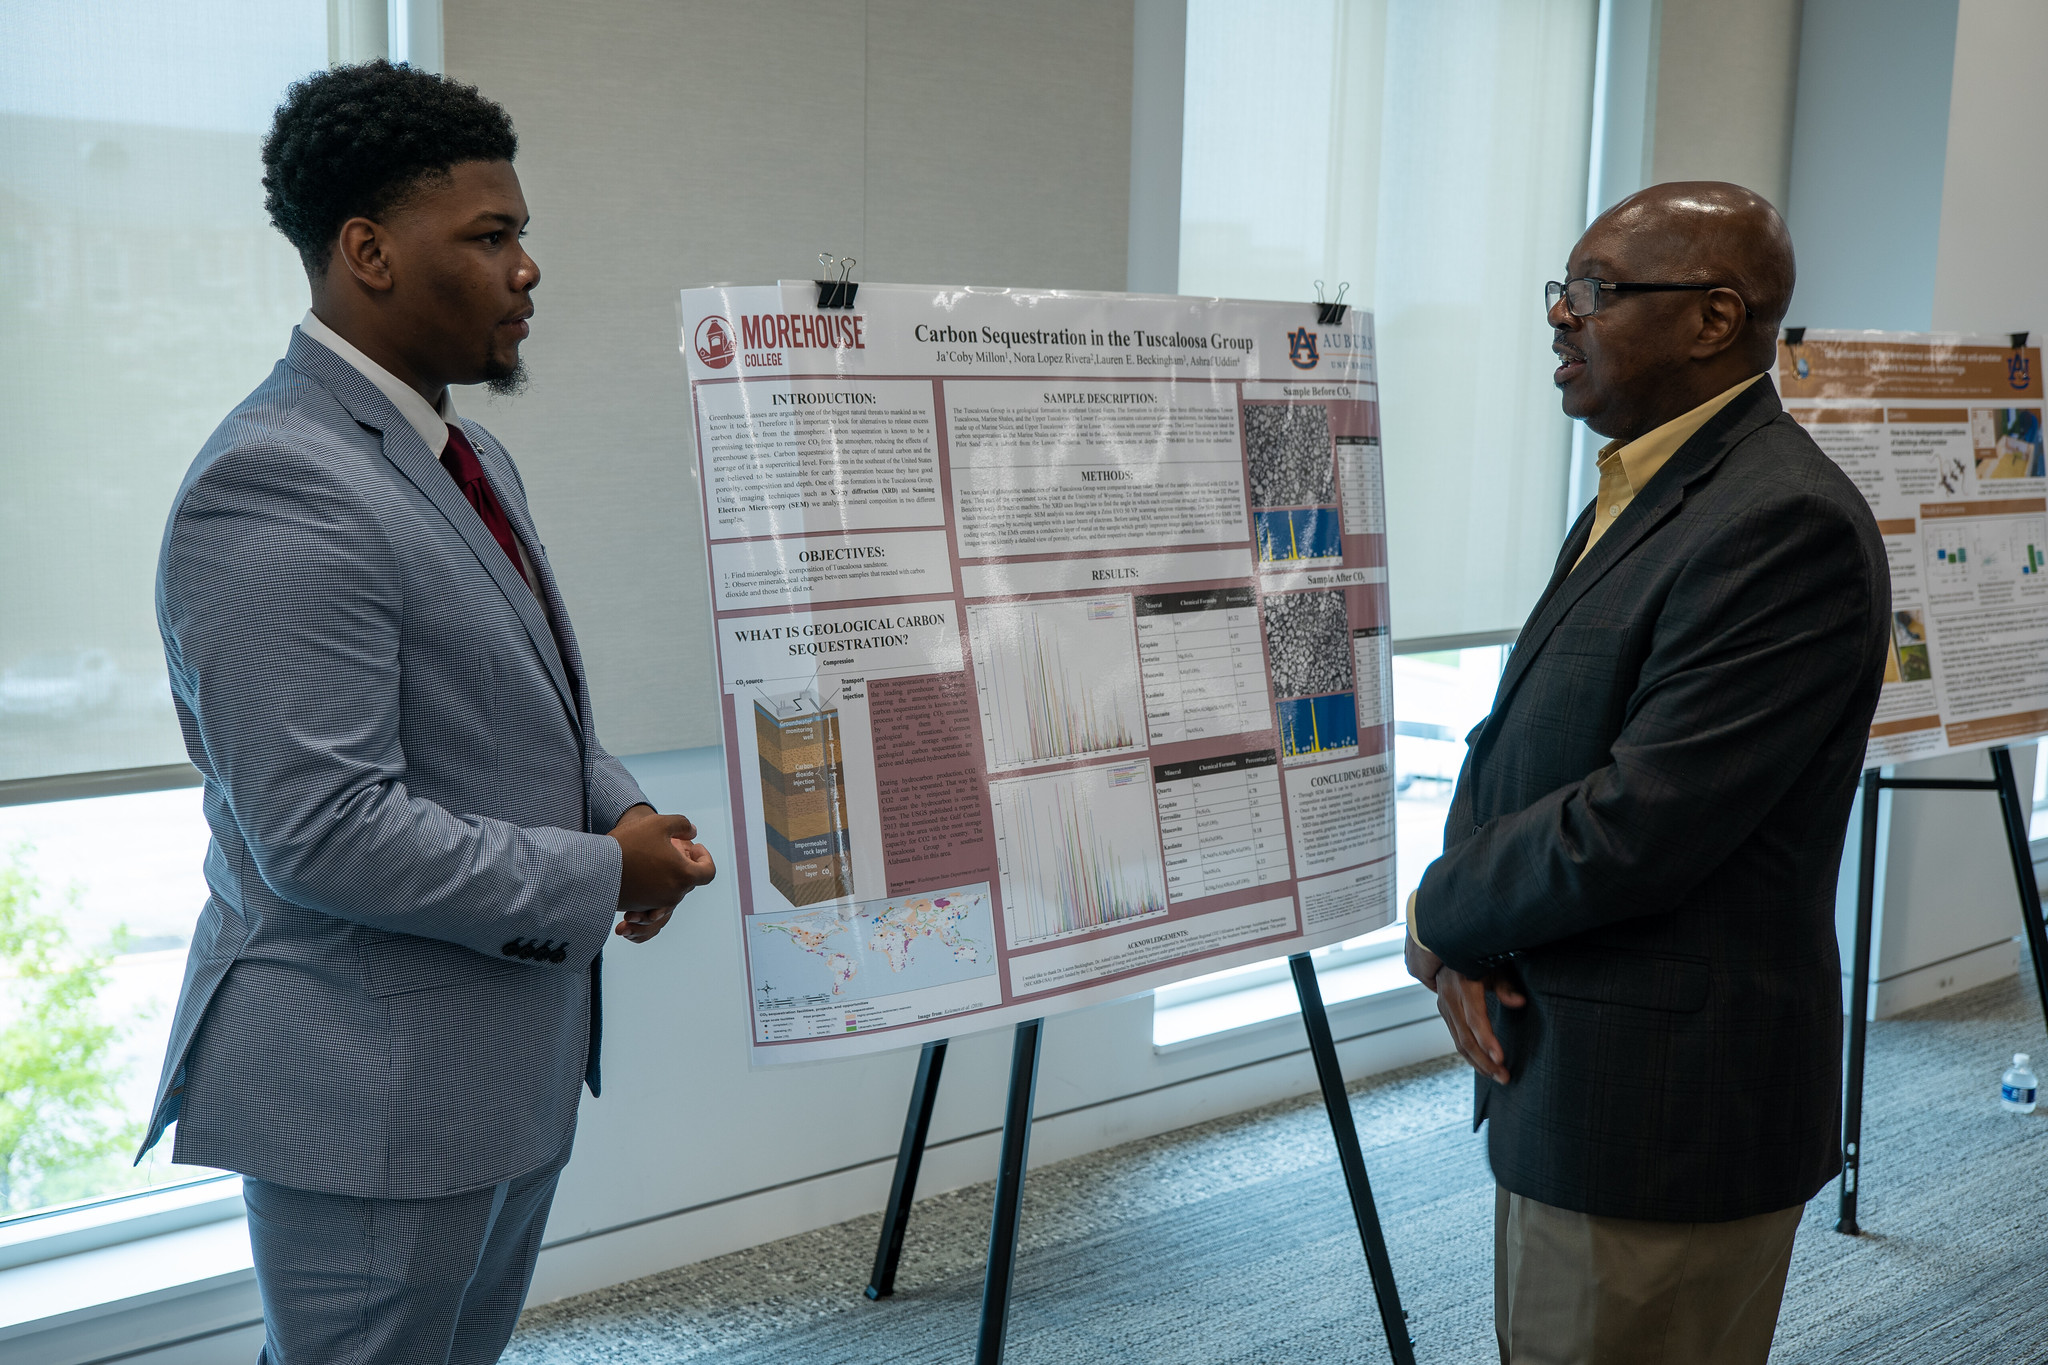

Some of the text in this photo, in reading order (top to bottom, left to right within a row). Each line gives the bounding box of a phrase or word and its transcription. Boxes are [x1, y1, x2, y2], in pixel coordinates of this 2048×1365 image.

[741, 314, 865, 350] MOREHOUSE
[914, 324, 1253, 354] Carbon Sequestration in the Tuscaloosa Group
[744, 353, 783, 367] COLLEGE
[1013, 352, 1035, 364] Nora
[1037, 353, 1063, 366] Lopez
[1126, 355, 1134, 365] E.
[1283, 387, 1310, 397] Sample
[1312, 387, 1336, 396] Before
[772, 393, 876, 405] INTRODUCTION:
[1043, 393, 1158, 404] SAMPLE DESCRIPTION:
[709, 413, 745, 421] Greenhouse
[780, 410, 803, 418] arguably
[1081, 470, 1133, 481] METHODS:
[718, 506, 746, 514] Electron
[789, 501, 810, 509] (SEM)
[799, 546, 885, 562] OBJECTIVES:
[731, 571, 746, 579] Find
[789, 565, 824, 575] composition
[833, 562, 862, 570] Tuscaloosa
[1091, 568, 1139, 581] RESULTS:
[732, 580, 757, 588] Observe
[800, 575, 825, 583] changes
[824, 572, 848, 580] between
[849, 571, 870, 579] samples
[1307, 575, 1334, 585] Sample
[1335, 572, 1352, 583] After
[725, 590, 749, 598] dioxide
[792, 585, 803, 593] did
[734, 613, 946, 643] WHAT IS GEOLOGICAL CARBON
[789, 634, 909, 657] SEQUESTRATION?
[822, 657, 855, 666] Compression
[745, 677, 763, 685] source
[842, 692, 865, 700] Injection
[780, 719, 813, 727] Groundwater
[785, 727, 813, 735] monitoring
[795, 770, 814, 778] dioxide
[1310, 769, 1361, 788] CONCLUDING
[793, 778, 815, 787] injection
[911, 810, 928, 818] USGS
[930, 806, 953, 815] published
[1160, 813, 1181, 821] Ferrosilite
[883, 823, 897, 831] 2013
[912, 818, 938, 827] mentioned
[950, 813, 961, 821] Gulf
[963, 811, 981, 819] Coastal
[1162, 826, 1183, 834] Muscovite
[794, 839, 827, 849] Impermeable
[795, 863, 817, 872] Injection
[1165, 858, 1188, 866] Glauconite
[1127, 930, 1189, 950] ACKNOWLEDGEMENTS:
